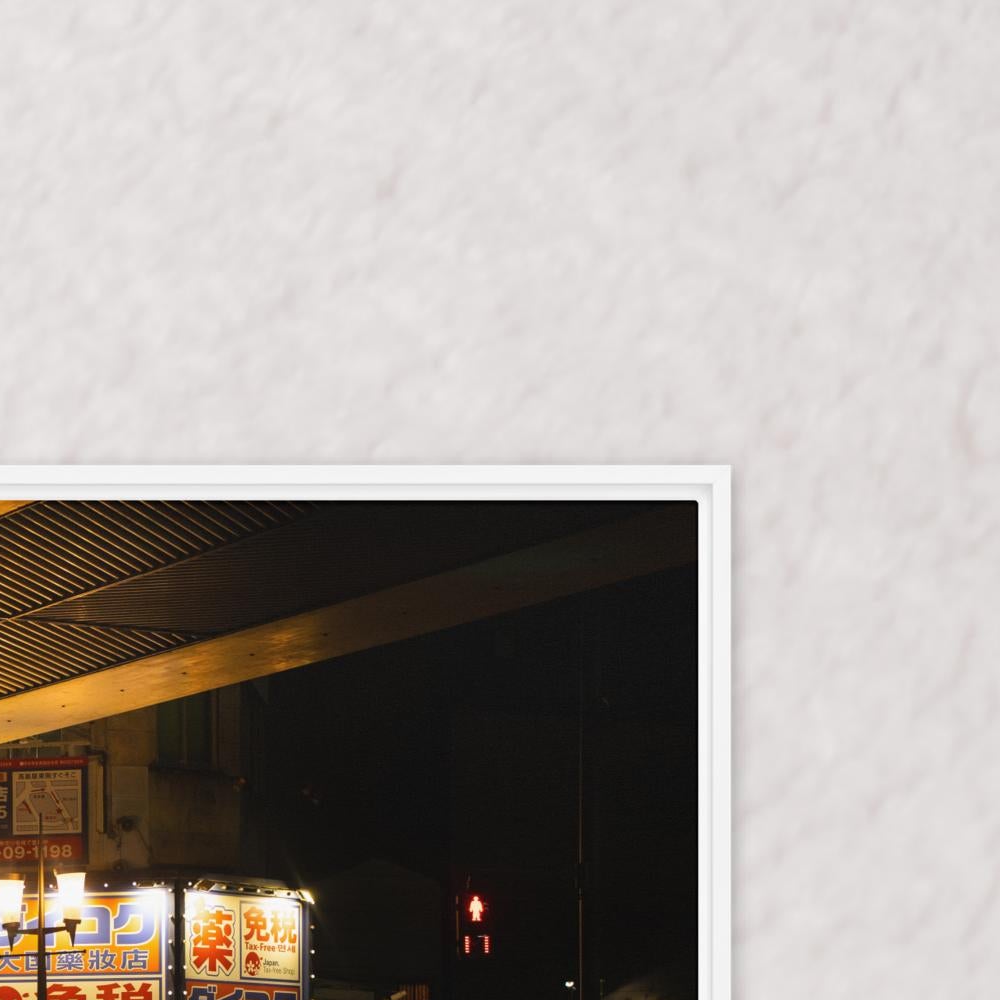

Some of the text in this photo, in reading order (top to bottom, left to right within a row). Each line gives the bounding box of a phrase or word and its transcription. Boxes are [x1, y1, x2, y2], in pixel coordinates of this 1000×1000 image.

[192, 908, 233, 973] 薬
[244, 906, 298, 944] 免税
[245, 942, 275, 951] Tax-Free
